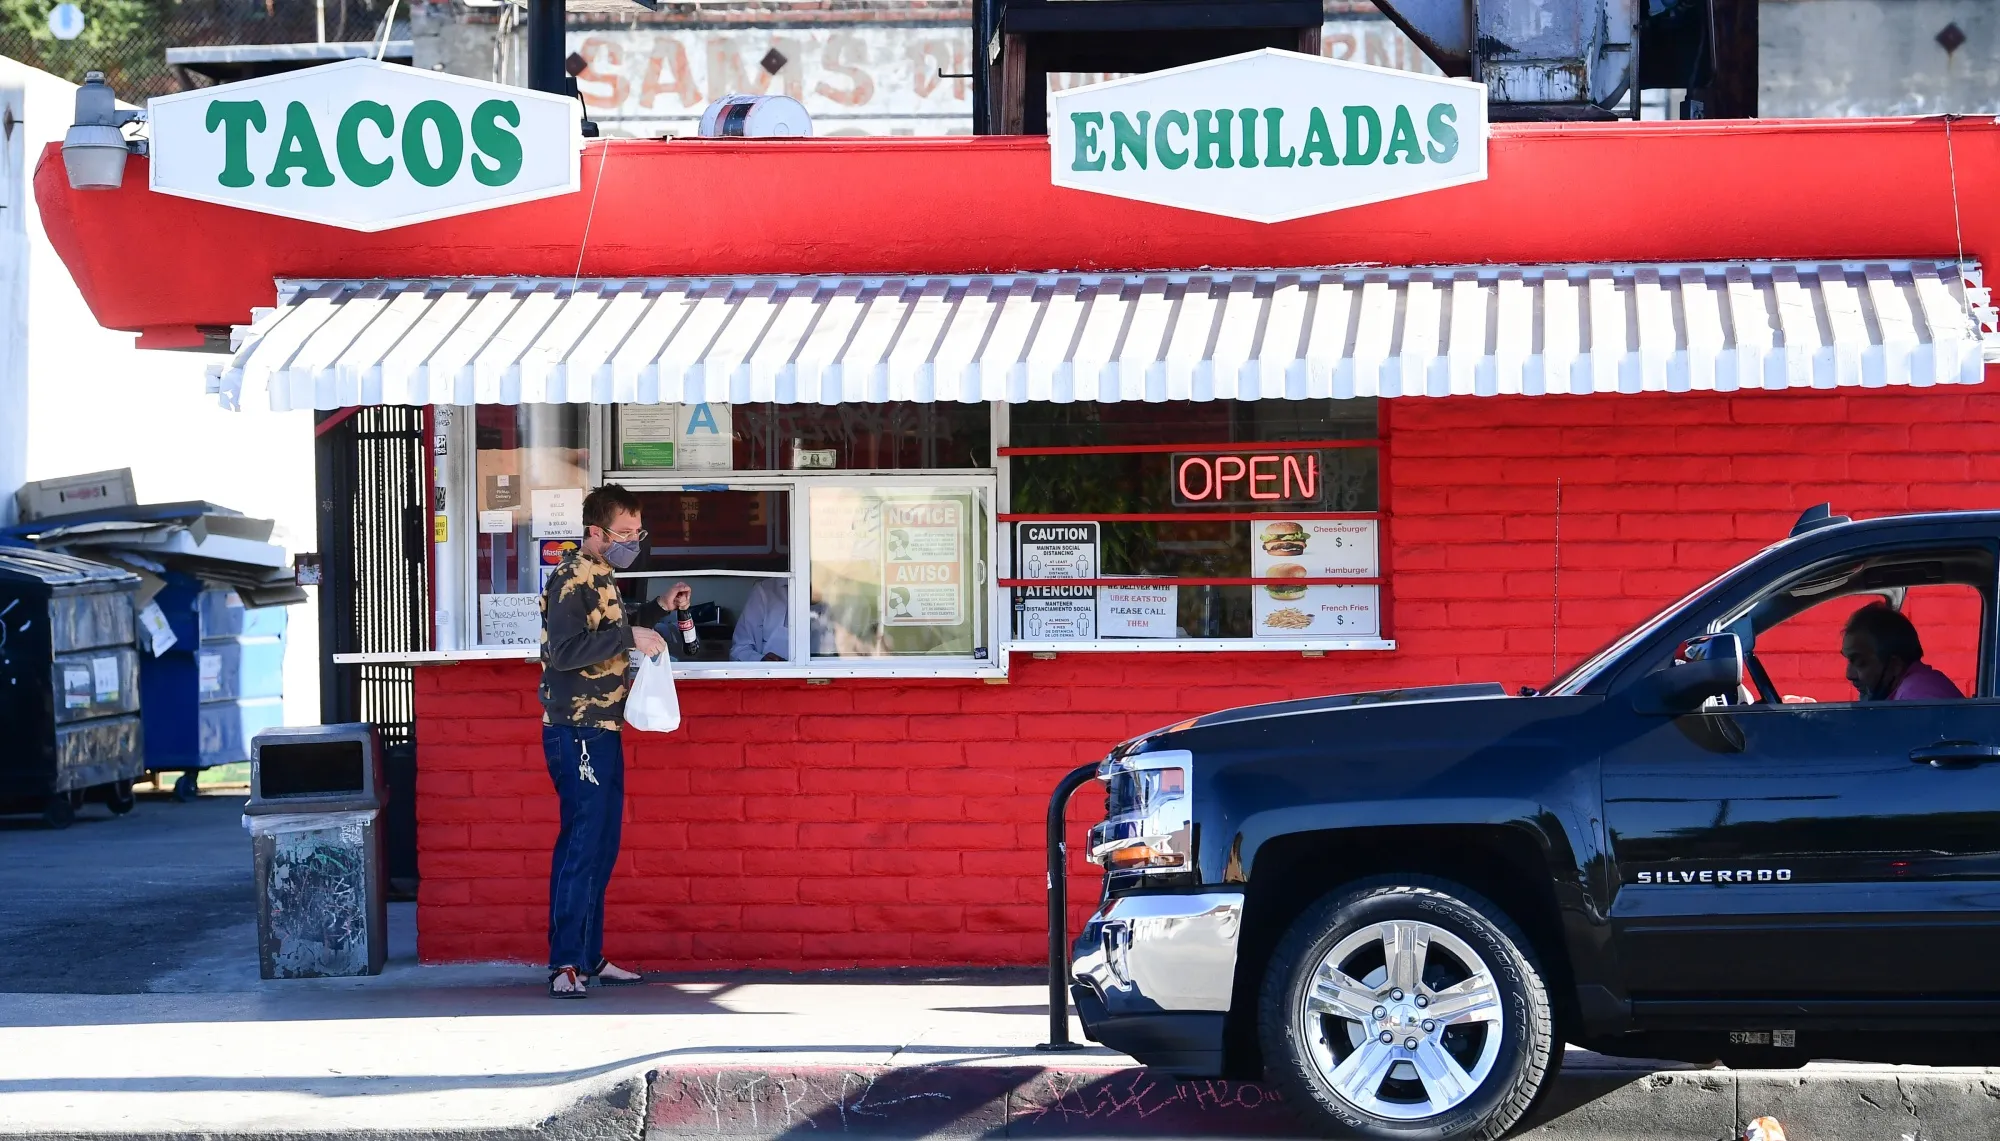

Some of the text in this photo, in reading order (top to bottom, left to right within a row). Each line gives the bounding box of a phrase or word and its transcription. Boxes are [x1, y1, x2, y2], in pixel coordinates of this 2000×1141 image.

[205, 99, 523, 188] TACOS
[1071, 103, 1459, 172] ENCHILADAS
[686, 402, 719, 435] A
[1179, 455, 1315, 501] OPEN
[889, 507, 956, 525] NOTICE
[1028, 527, 1088, 541] CAUTION
[896, 565, 950, 582] AVISO
[1025, 585, 1093, 597] ATENCION
[1110, 594, 1129, 602] UBER
[489, 608, 541, 621] Cheeseburge
[1110, 607, 1142, 615] PLEASE
[1637, 869, 1792, 884] SILVERADO
[1418, 899, 1520, 984] SCORPION
[1512, 991, 1526, 1042] ATR
[1292, 1058, 1362, 1128] PIRELLI
